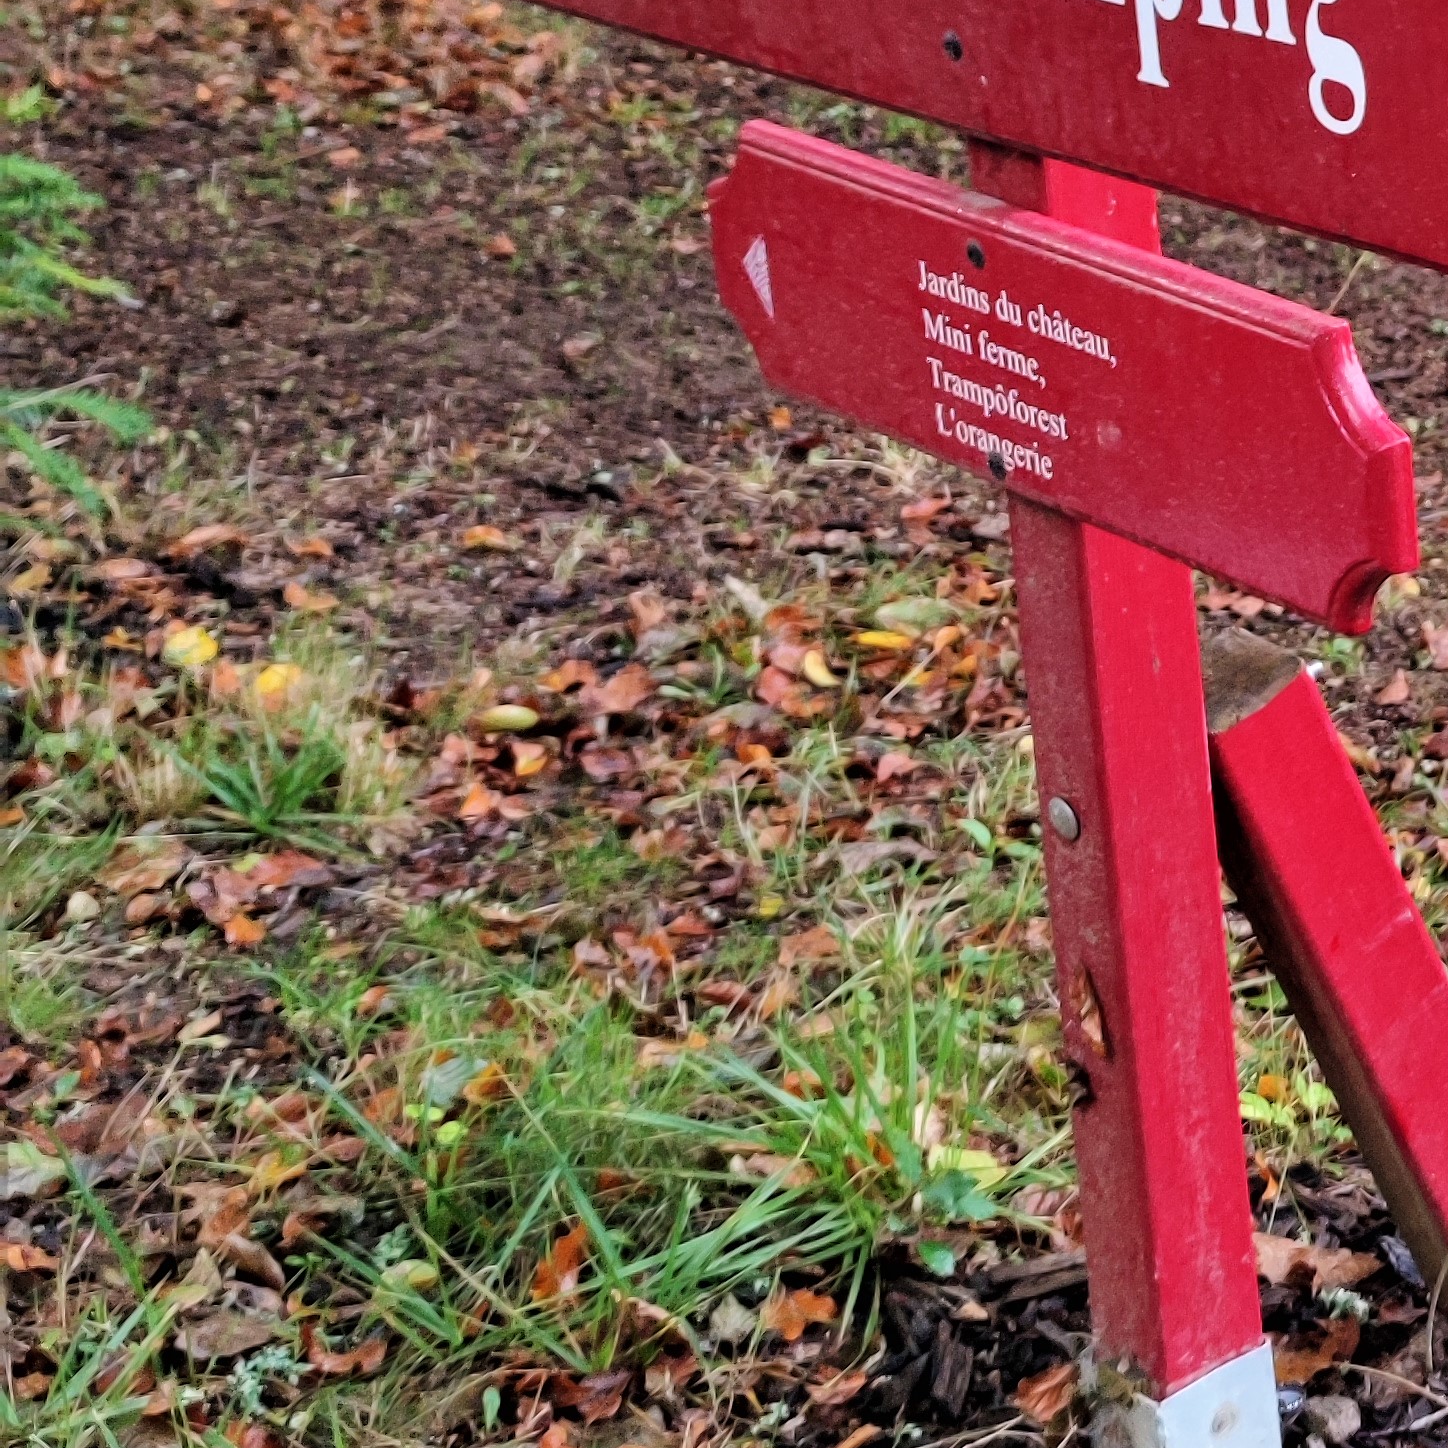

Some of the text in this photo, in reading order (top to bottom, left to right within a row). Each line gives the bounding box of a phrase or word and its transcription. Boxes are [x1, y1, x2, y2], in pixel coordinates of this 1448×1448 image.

[918, 260, 1117, 368] Jardins du château,
[921, 308, 1047, 389] Mini ferme,
[926, 356, 1069, 441] Trampôforest
[935, 402, 1054, 480] L'orangerie
